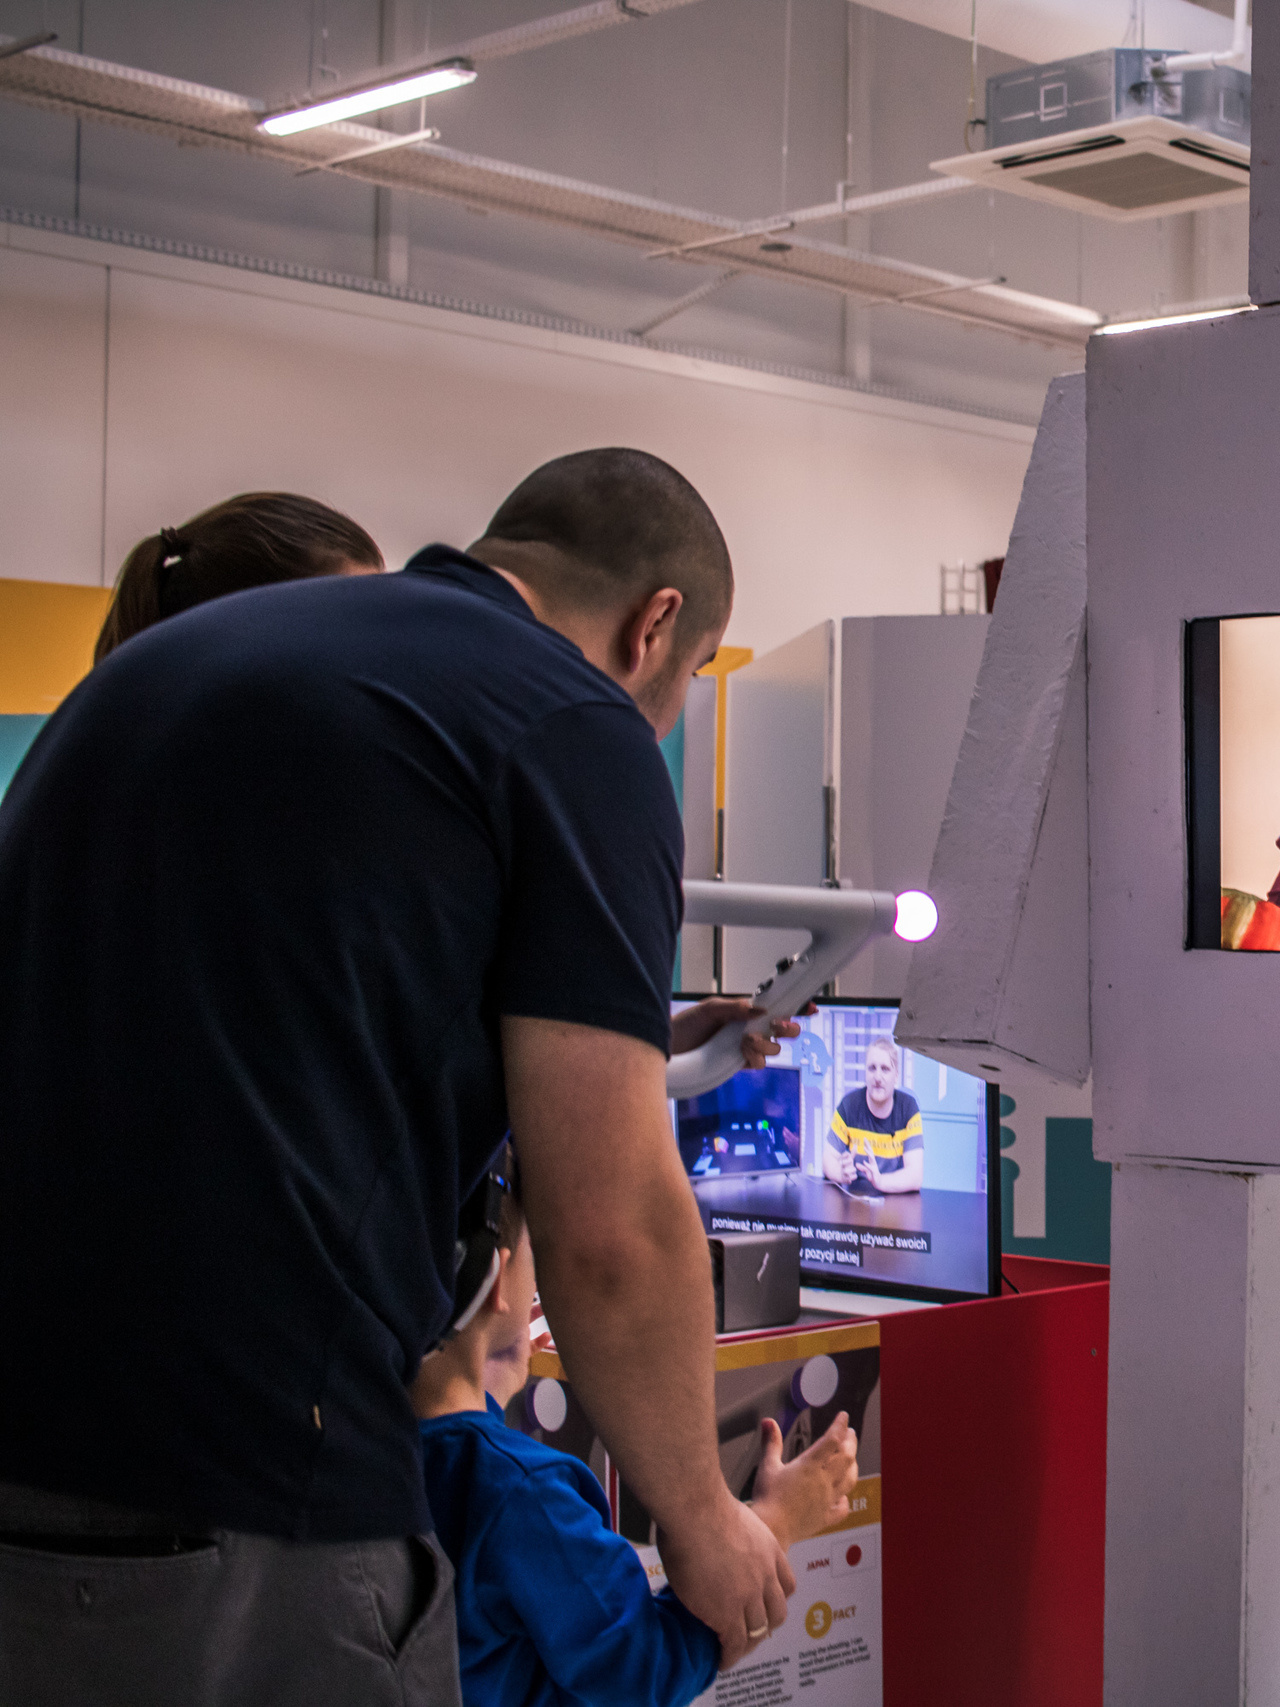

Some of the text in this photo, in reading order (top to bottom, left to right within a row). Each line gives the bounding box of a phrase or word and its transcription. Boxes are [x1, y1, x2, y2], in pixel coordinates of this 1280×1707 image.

[712, 1217, 751, 1232] ponieważ
[800, 1225, 815, 1239] tak
[815, 1228, 859, 1246] naprawdę
[860, 1231, 895, 1249] używać
[895, 1236, 928, 1251] swoich
[804, 1248, 835, 1264] pozycji
[836, 1250, 860, 1268] takiej
[806, 1557, 830, 1572] JAPAN
[812, 1605, 857, 1631] 3 FACT
